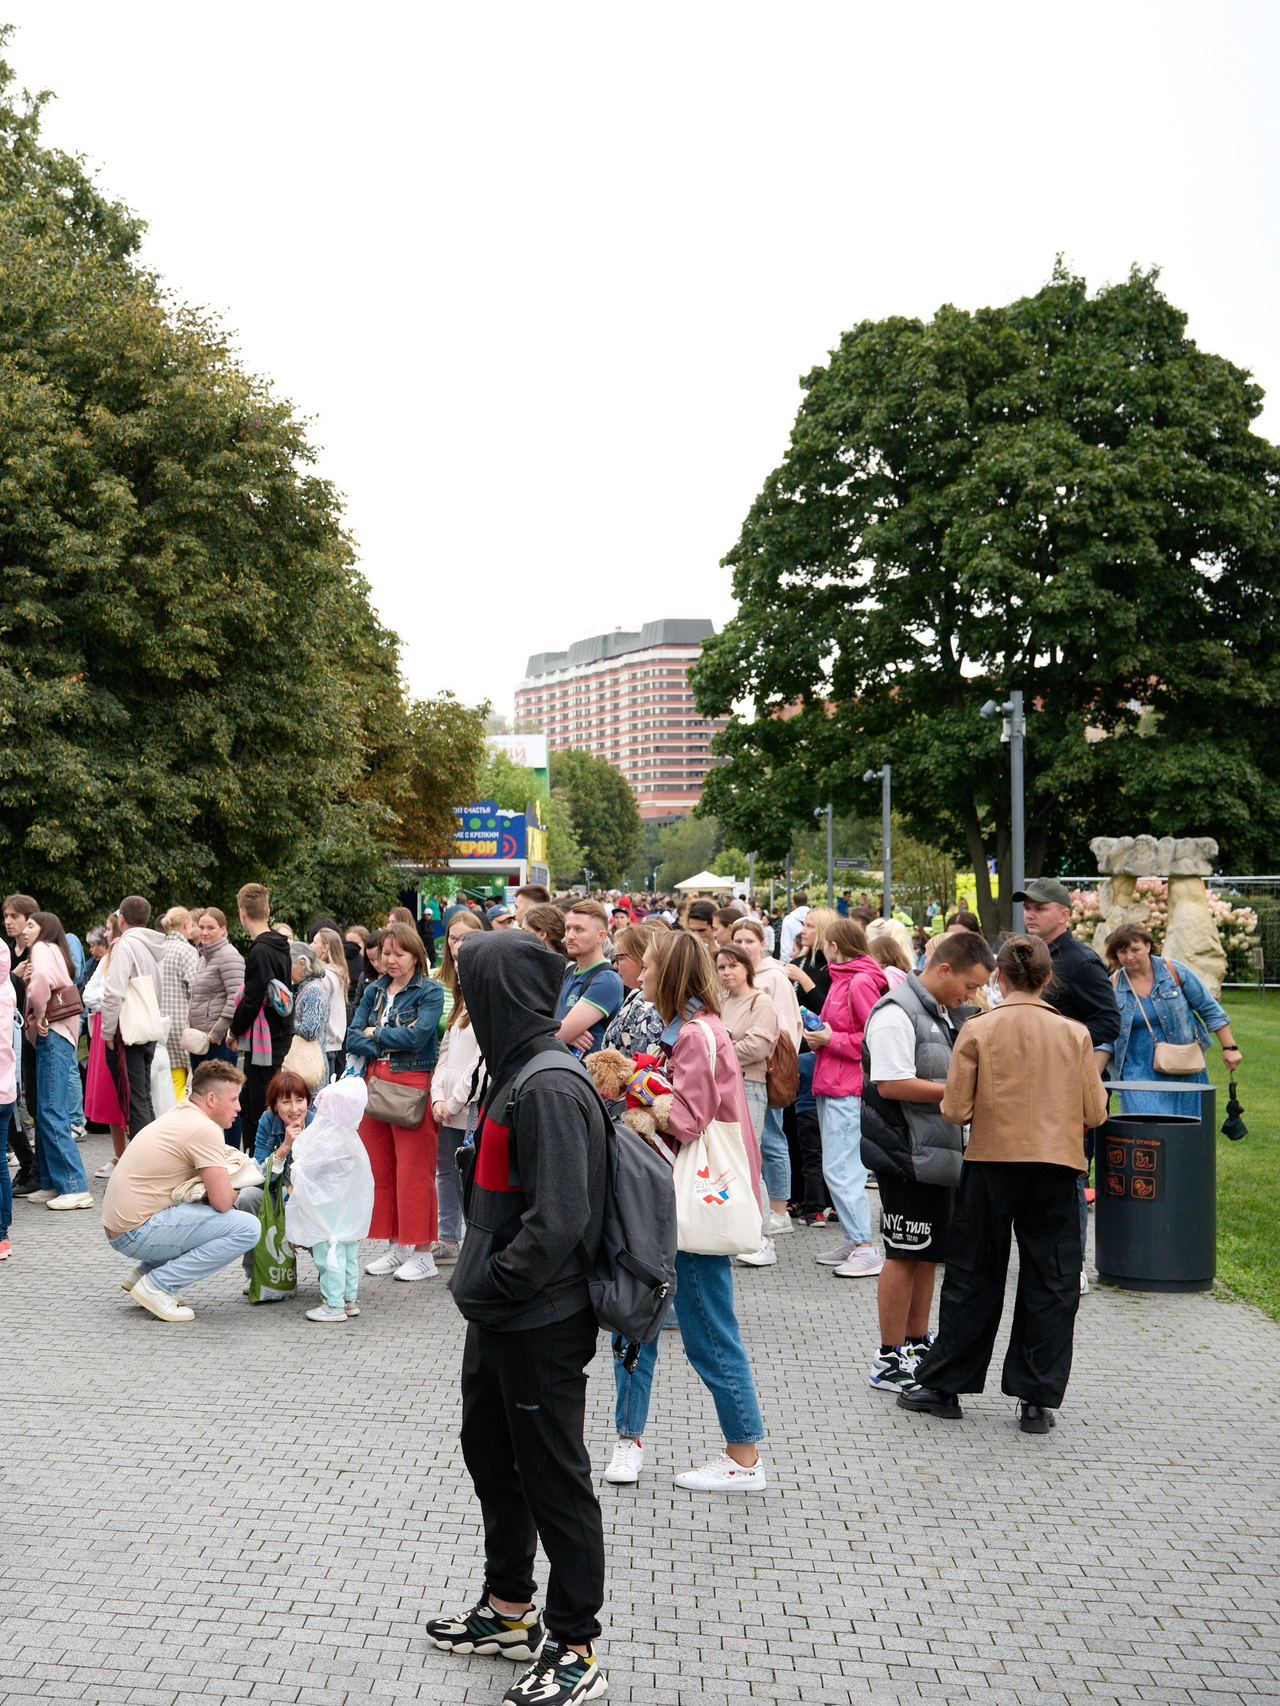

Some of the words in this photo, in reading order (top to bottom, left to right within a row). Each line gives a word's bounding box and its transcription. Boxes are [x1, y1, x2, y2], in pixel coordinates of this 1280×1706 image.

[464, 806, 491, 814] СЧАСТЬЯ
[470, 831, 499, 839] КРЕПКИМ
[456, 840, 497, 857] ЕРОМ
